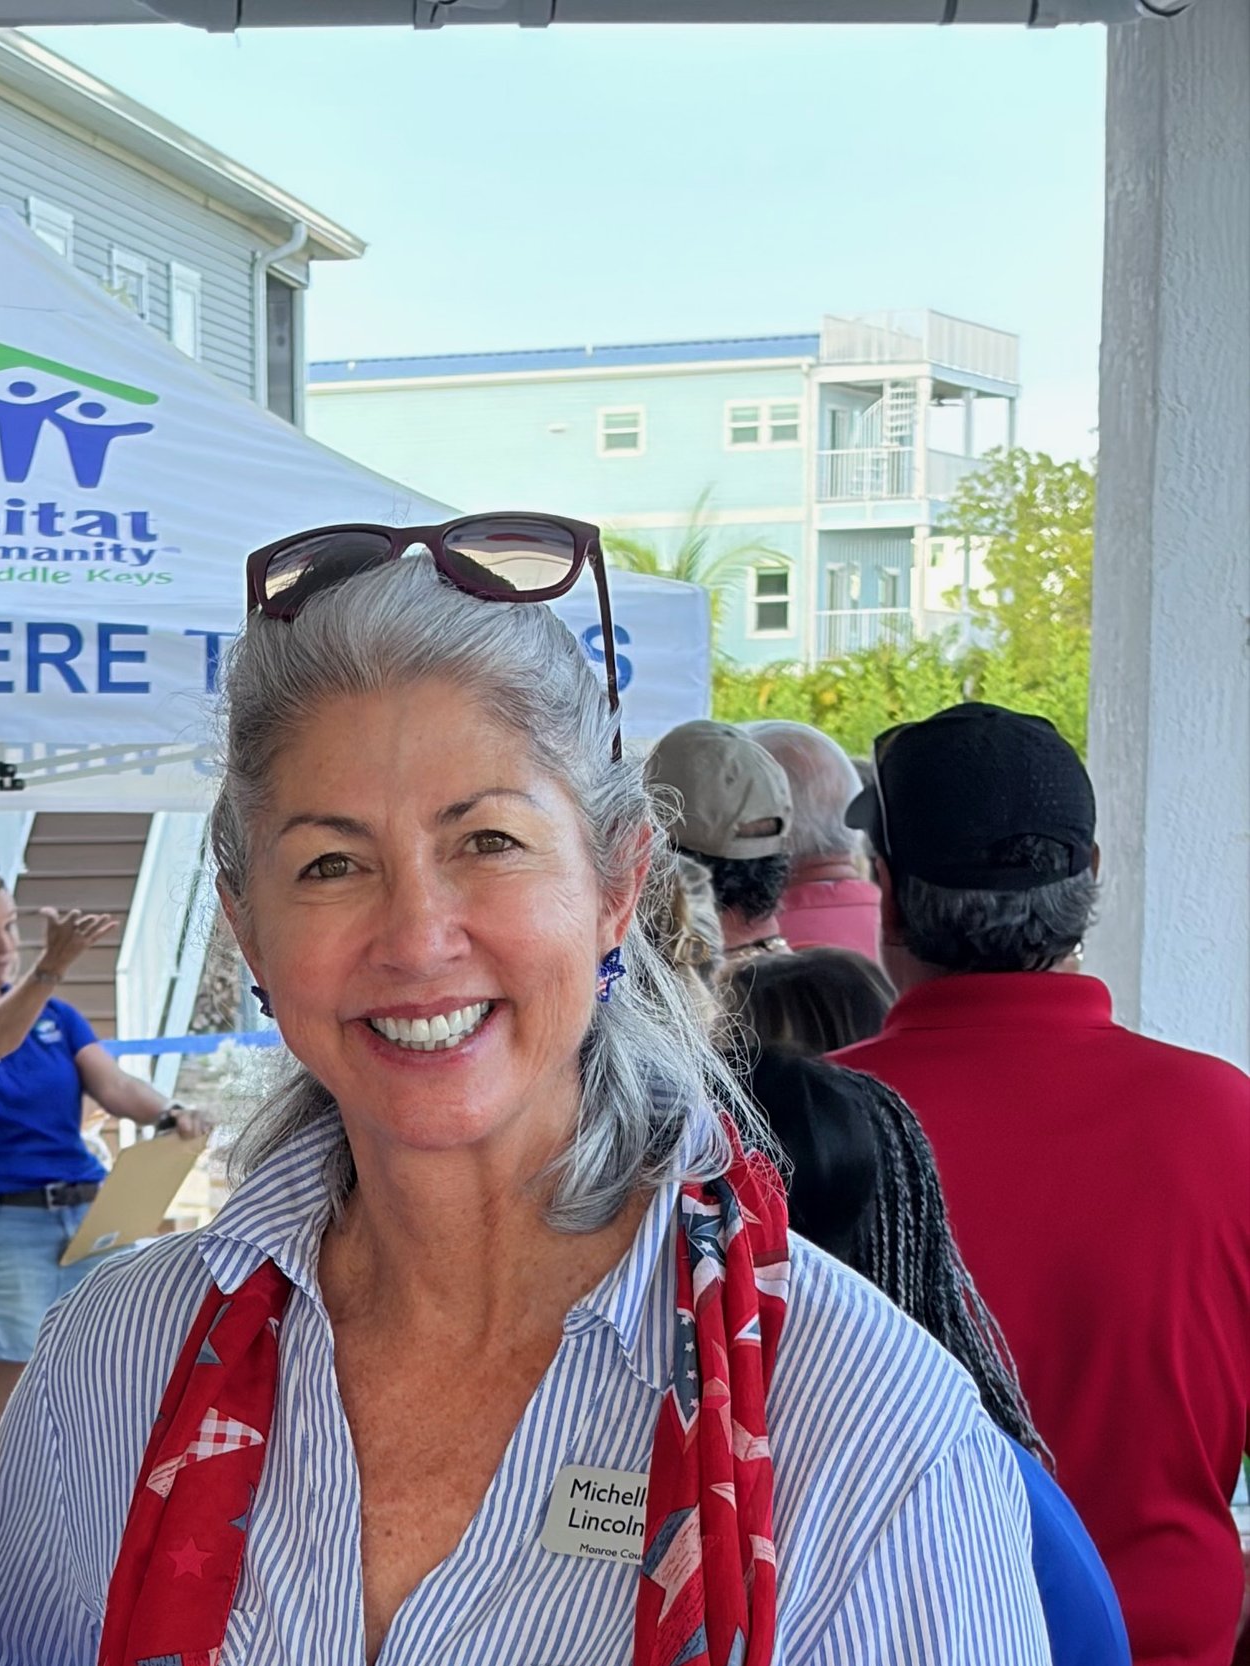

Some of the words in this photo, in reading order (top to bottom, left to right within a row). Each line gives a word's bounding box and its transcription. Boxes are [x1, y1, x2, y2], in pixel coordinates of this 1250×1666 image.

[87, 567, 174, 586] Keys
[570, 1479, 646, 1508] Michell
[568, 1507, 645, 1537] Lincoln
[579, 1544, 618, 1557] Monroe
